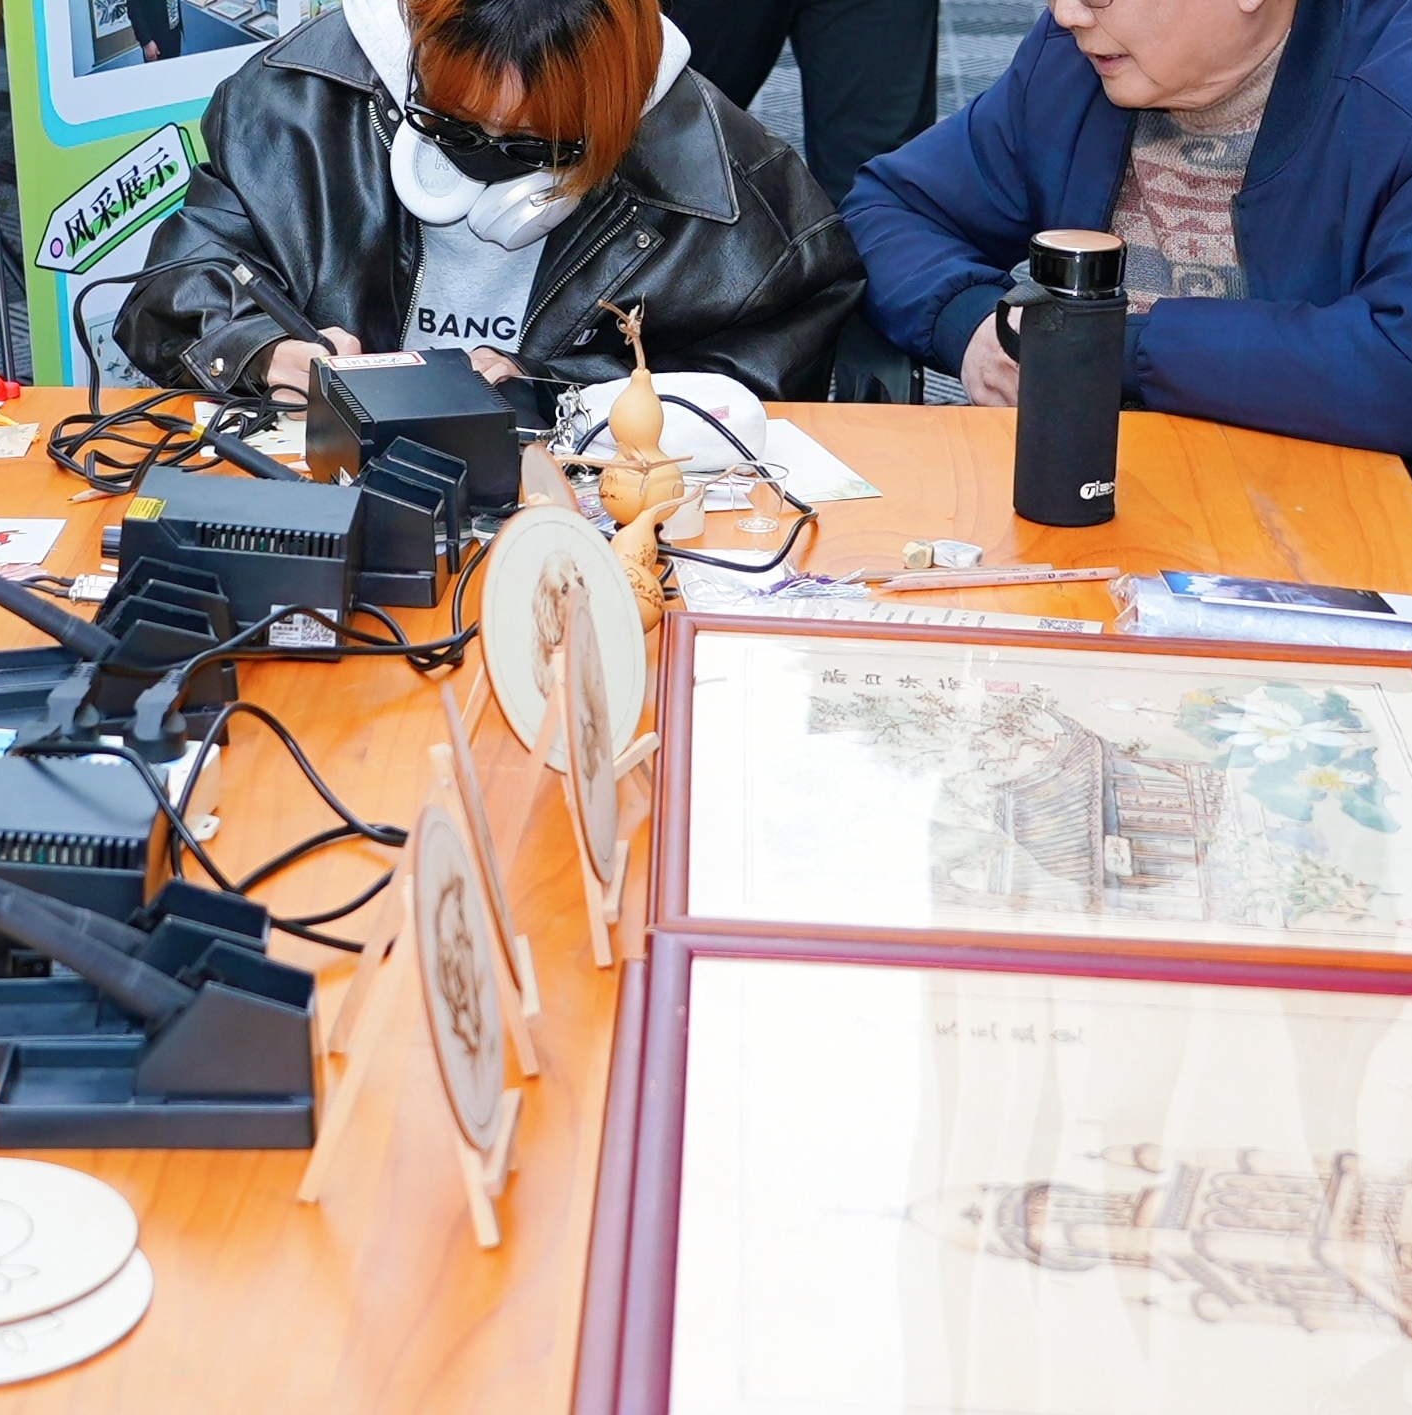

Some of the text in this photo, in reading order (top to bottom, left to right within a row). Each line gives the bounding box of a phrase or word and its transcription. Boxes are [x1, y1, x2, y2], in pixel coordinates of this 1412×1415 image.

[64, 146, 180, 260] 风采展示
[418, 307, 517, 341] BANG
